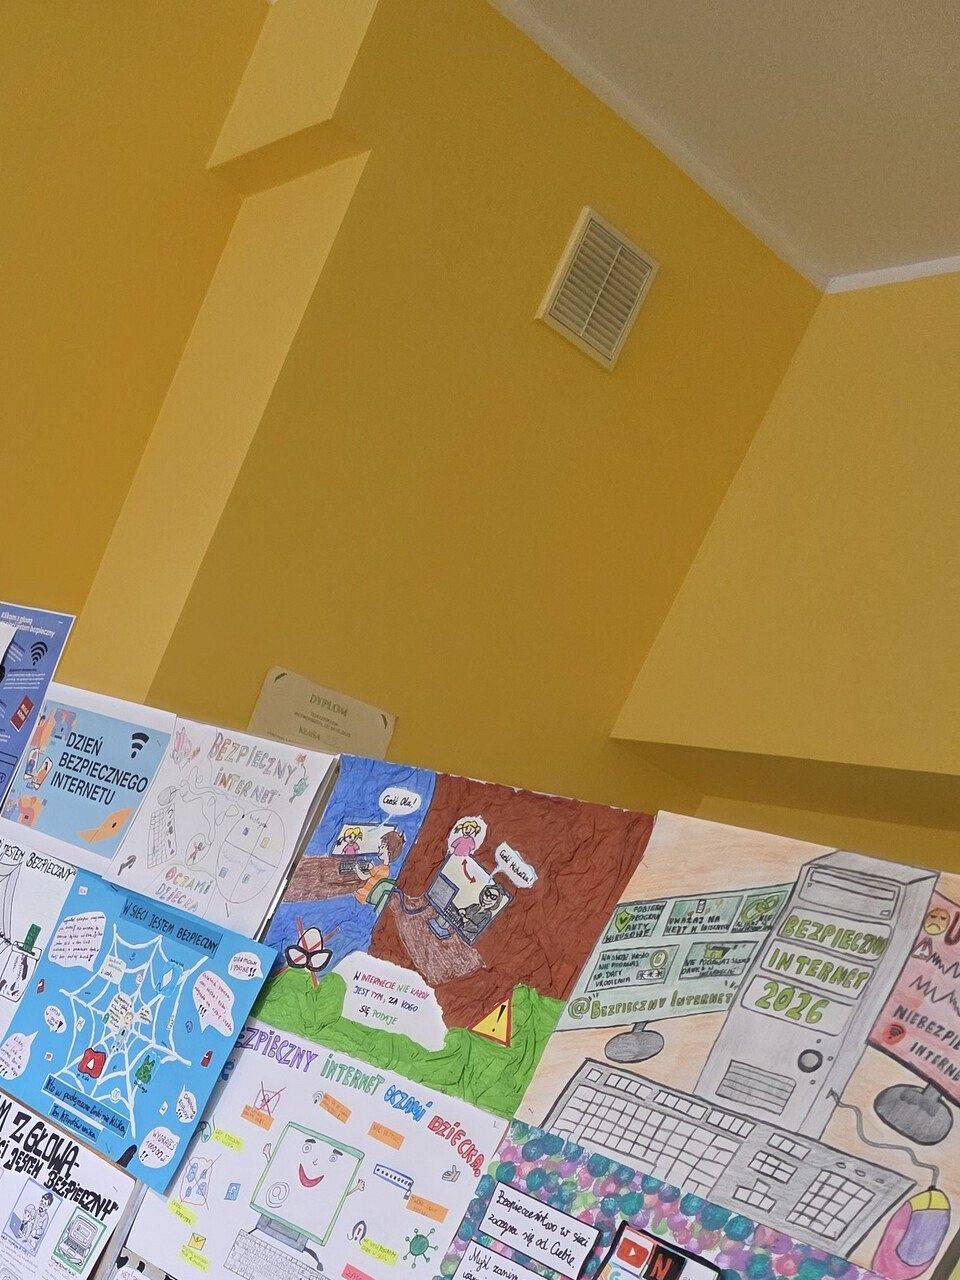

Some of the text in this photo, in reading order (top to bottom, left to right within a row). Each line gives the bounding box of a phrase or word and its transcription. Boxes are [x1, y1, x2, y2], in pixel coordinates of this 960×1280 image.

[66, 731, 104, 757] DZIEŃ
[210, 730, 296, 785] BEZPIECZNY
[50, 772, 117, 806] INTERNETU
[58, 751, 149, 794] BEZPIECZNEGO
[148, 913, 218, 954] JESTEM BEZPIECZNY
[353, 972, 410, 993] W INTERNECIE NIE
[766, 947, 870, 990] INTERNET
[353, 985, 370, 997] JEST
[388, 997, 398, 1005] ZA
[401, 1000, 418, 1012] KOGO
[359, 1005, 398, 1025] SIĘ PODAJE
[754, 981, 832, 1025] 2026
[319, 1052, 433, 1122] INTERNET OCZAMI
[9, 1111, 32, 1144] Z
[3, 1147, 46, 1180] JESTEM
[522, 1229, 535, 1248] się
[536, 1235, 549, 1251] od
[559, 1228, 571, 1238] w
